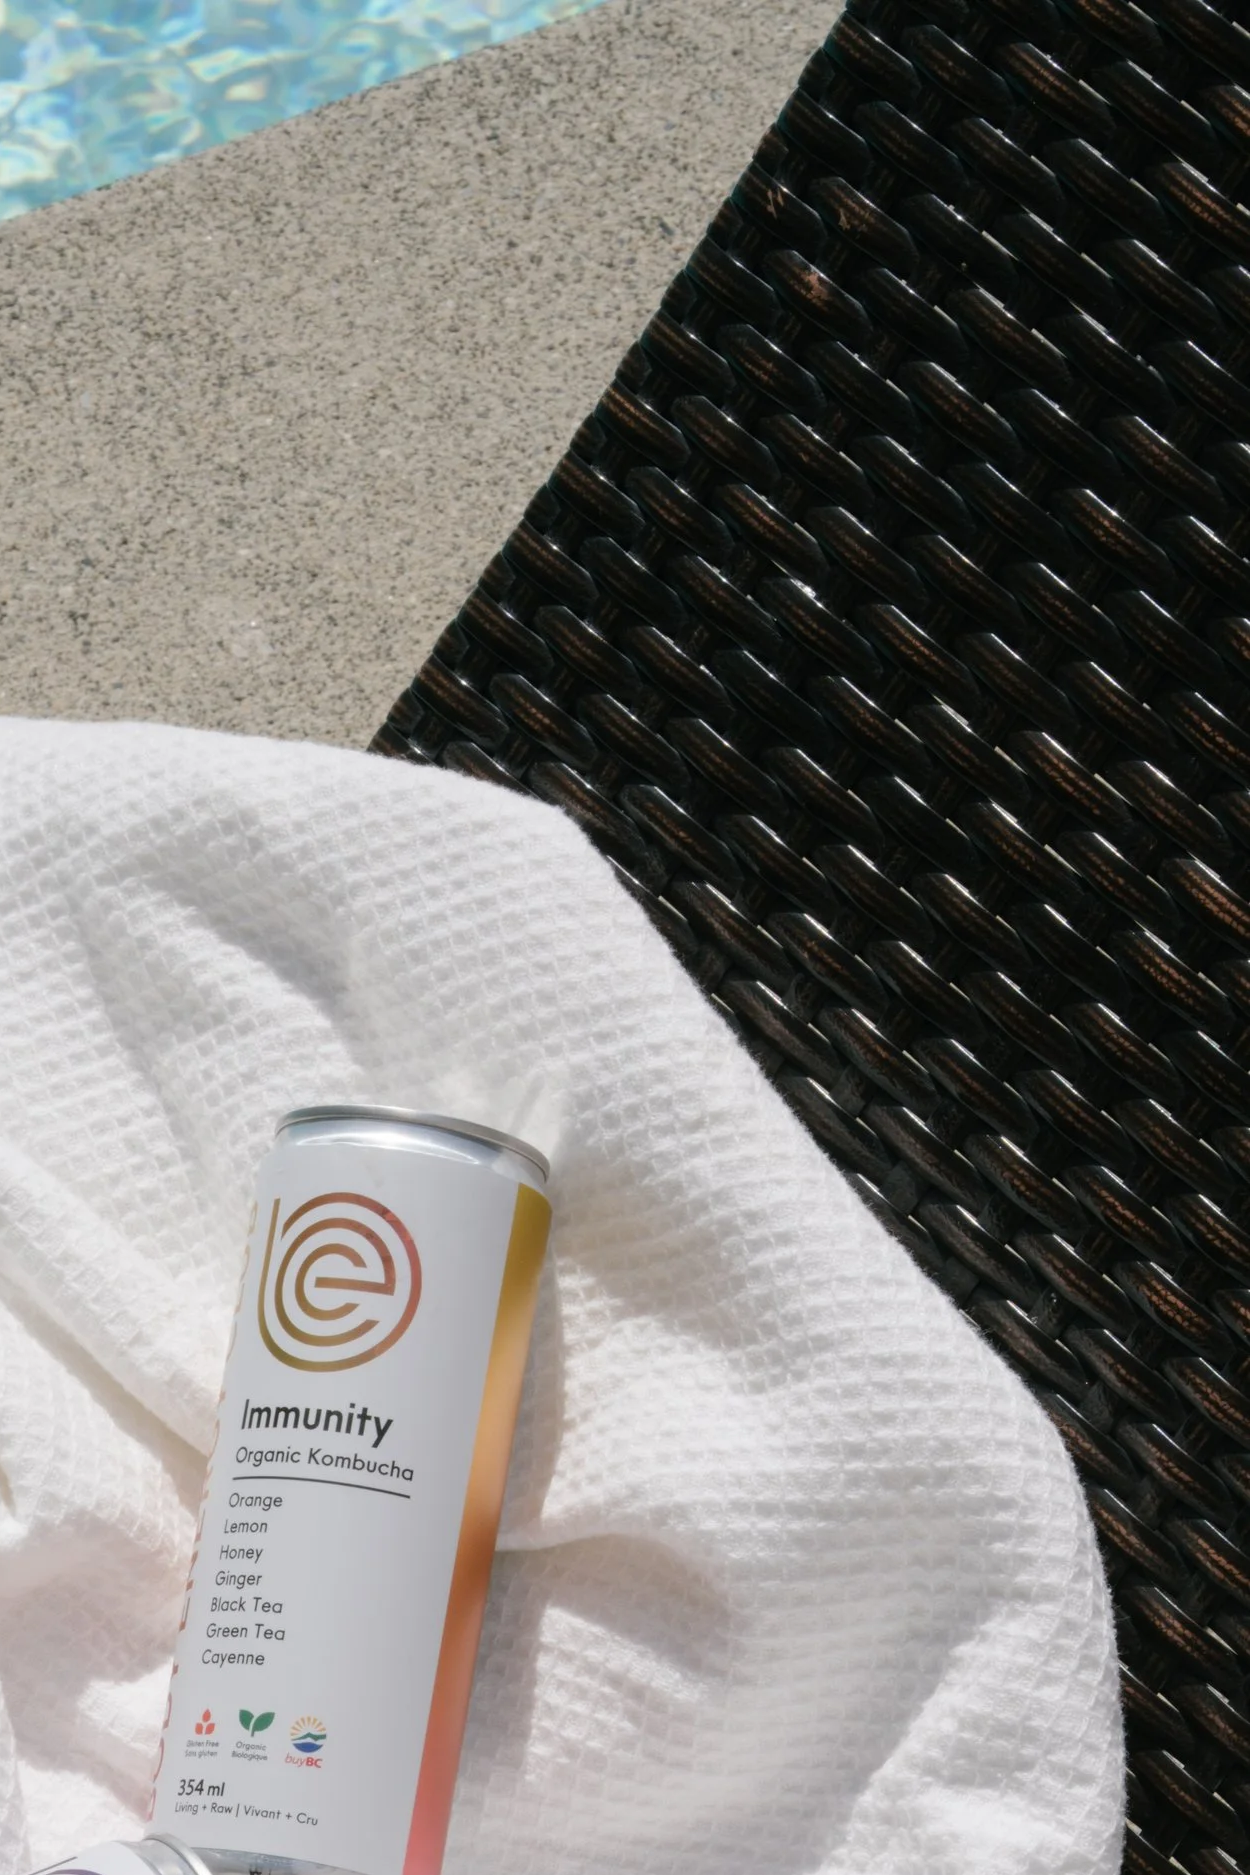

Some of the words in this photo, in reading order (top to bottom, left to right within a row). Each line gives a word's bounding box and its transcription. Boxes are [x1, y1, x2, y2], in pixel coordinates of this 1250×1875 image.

[241, 1399, 393, 1449] Immunity
[235, 1446, 301, 1467] Organic
[307, 1448, 414, 1481] Kombucha
[228, 1492, 283, 1511] Orange
[223, 1519, 268, 1534] Lemon
[219, 1545, 263, 1564] Honey
[214, 1571, 262, 1589] Ginger
[210, 1597, 246, 1612] Black
[253, 1597, 283, 1614] Tea
[206, 1623, 248, 1638] Green
[254, 1624, 286, 1641] Tea
[201, 1649, 265, 1668] Cayenne
[236, 1741, 266, 1752] Organic
[231, 1750, 268, 1762] Biologique
[284, 1752, 324, 1768] buyBC
[178, 1779, 204, 1796] 354
[207, 1782, 225, 1797] ml
[174, 1801, 199, 1814] Living
[210, 1802, 232, 1814] Raw
[244, 1806, 282, 1820] Vivant
[296, 1813, 318, 1826] Cru
